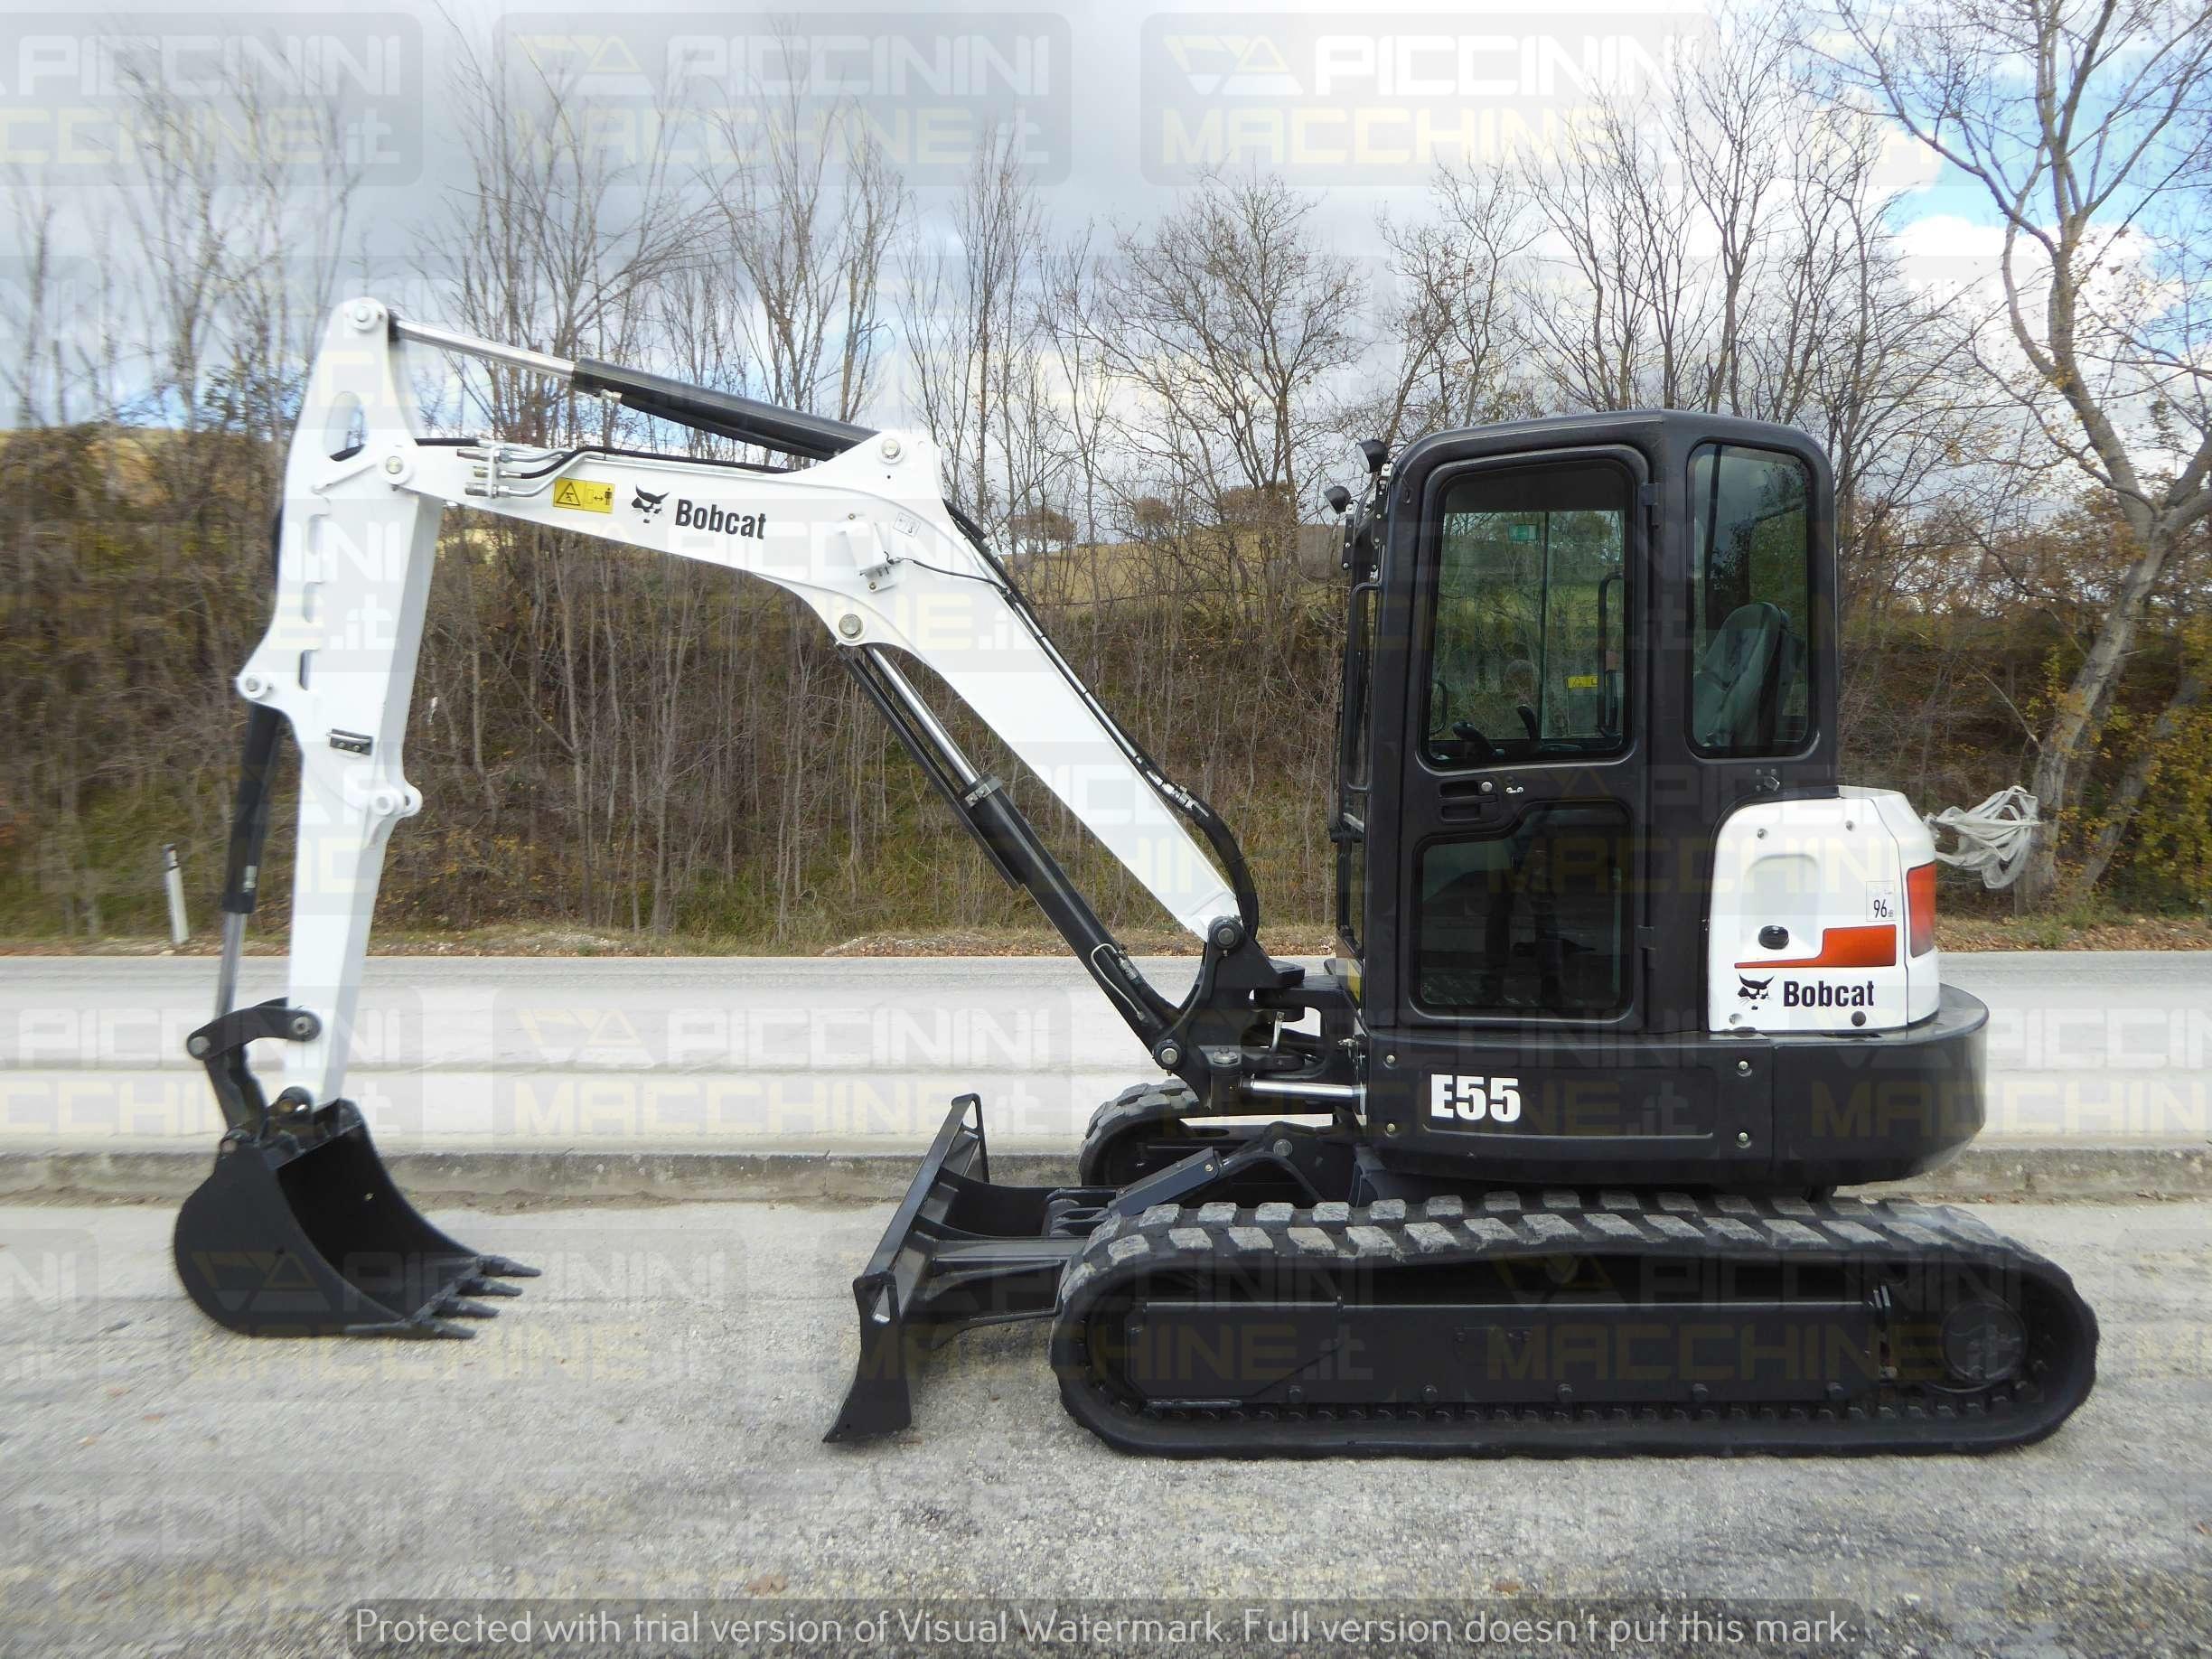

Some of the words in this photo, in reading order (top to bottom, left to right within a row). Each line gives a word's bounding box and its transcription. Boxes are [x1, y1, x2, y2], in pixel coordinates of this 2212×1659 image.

[675, 498, 767, 540] Bobcat
[1873, 898, 1888, 918] 96
[1784, 980, 1874, 1007] Bobcat
[1430, 1073, 1522, 1122] E55
